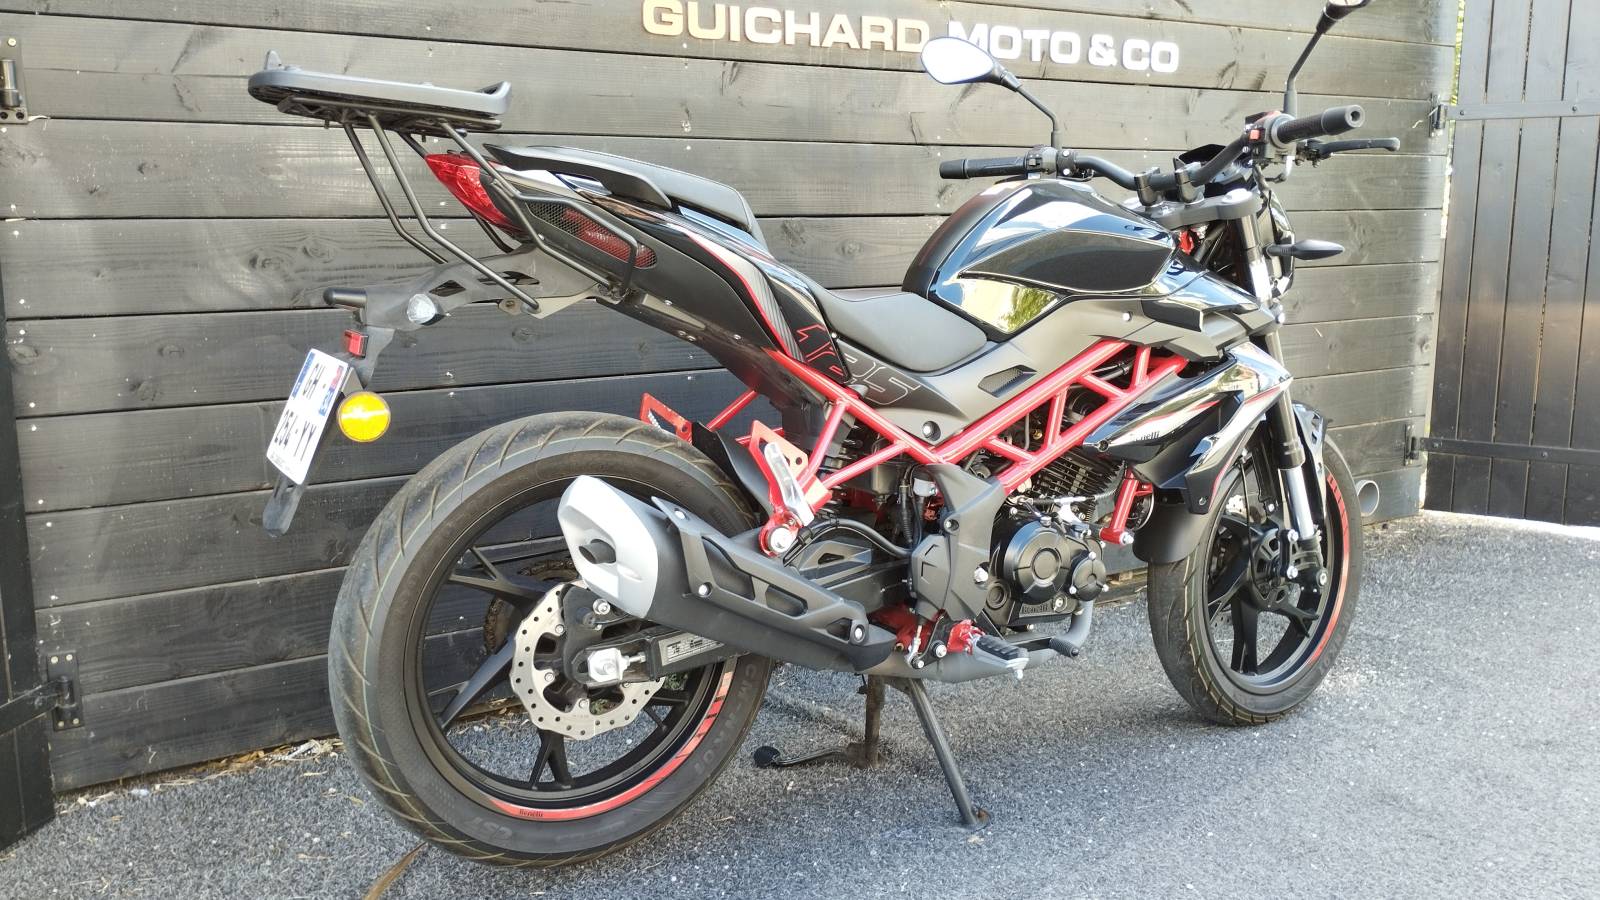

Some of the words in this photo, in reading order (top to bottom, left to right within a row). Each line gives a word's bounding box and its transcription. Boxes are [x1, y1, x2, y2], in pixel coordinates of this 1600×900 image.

[643, 0, 930, 53] GUICHARD
[1087, 33, 1118, 67] &
[1122, 38, 1180, 73] CO
